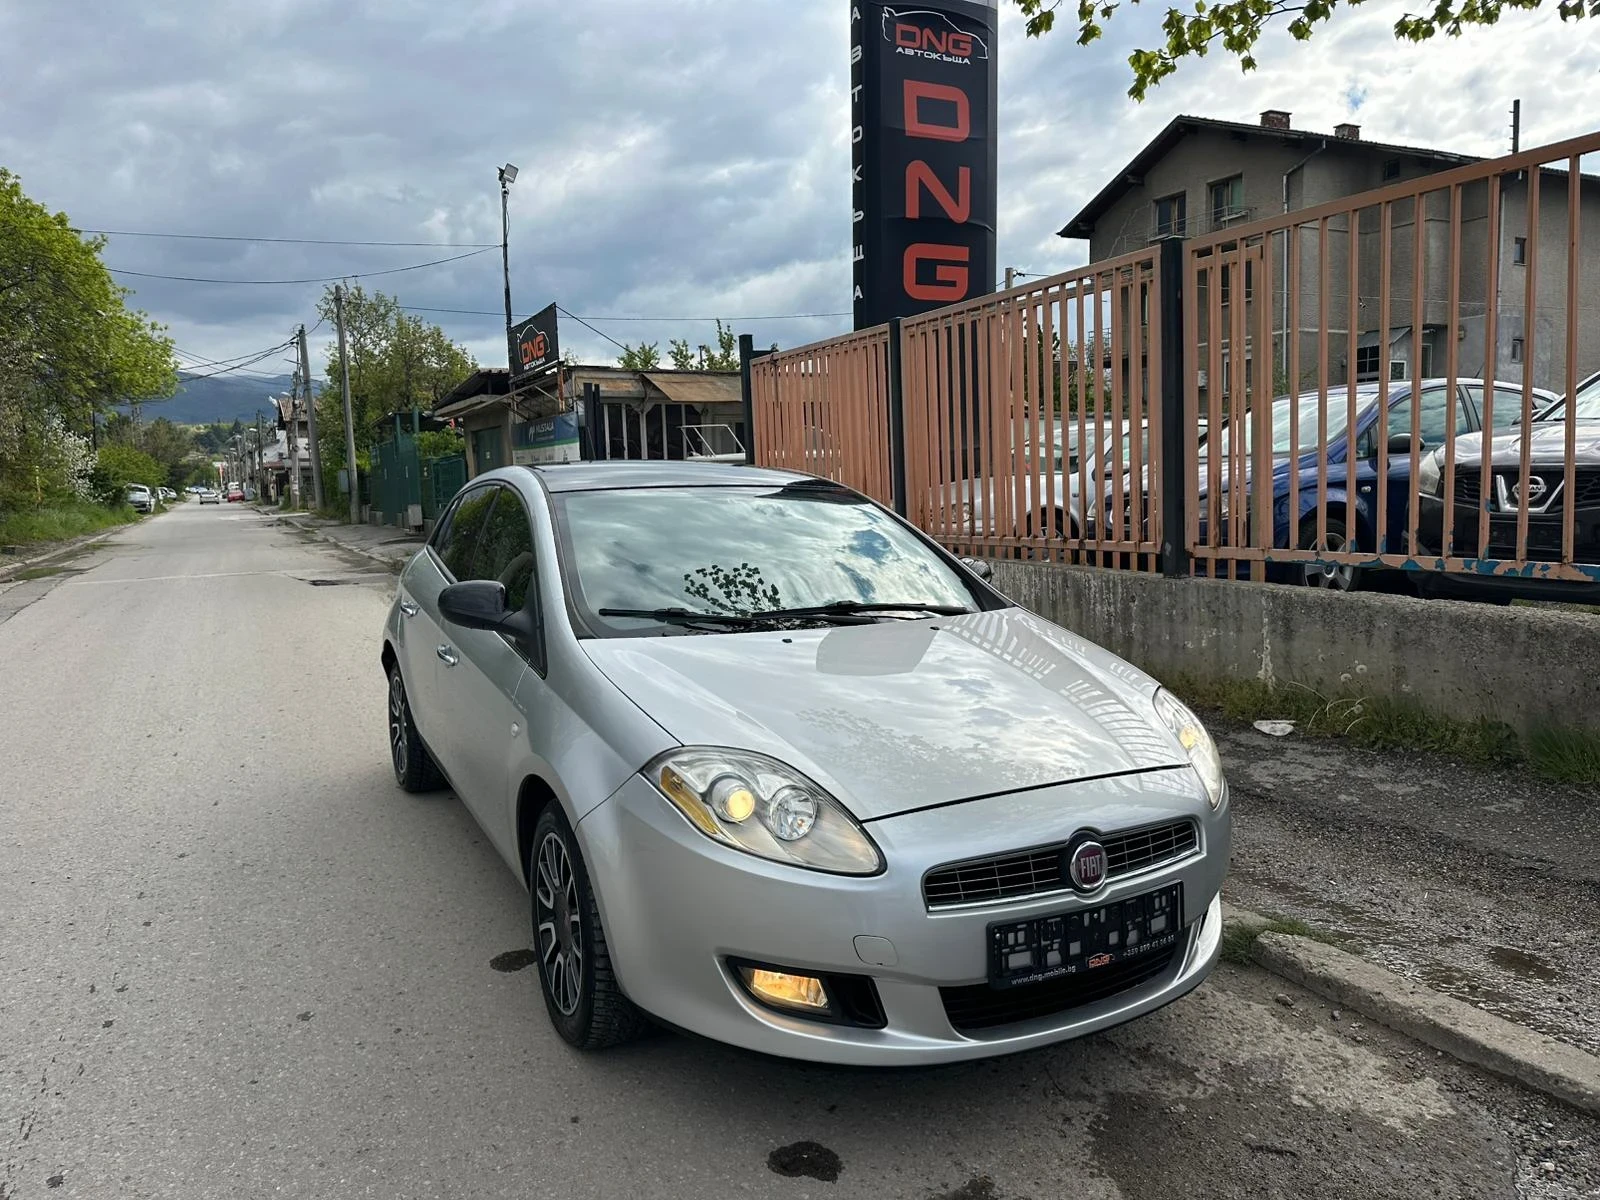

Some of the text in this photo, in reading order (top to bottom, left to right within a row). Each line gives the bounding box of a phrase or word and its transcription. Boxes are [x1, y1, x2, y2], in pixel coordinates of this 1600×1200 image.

[896, 23, 972, 57] DNG
[903, 79, 970, 302] DNG
[521, 334, 544, 363] DNG
[1080, 854, 1100, 878] FIAT
[1011, 965, 1076, 985] www.dng.mobile.bg
